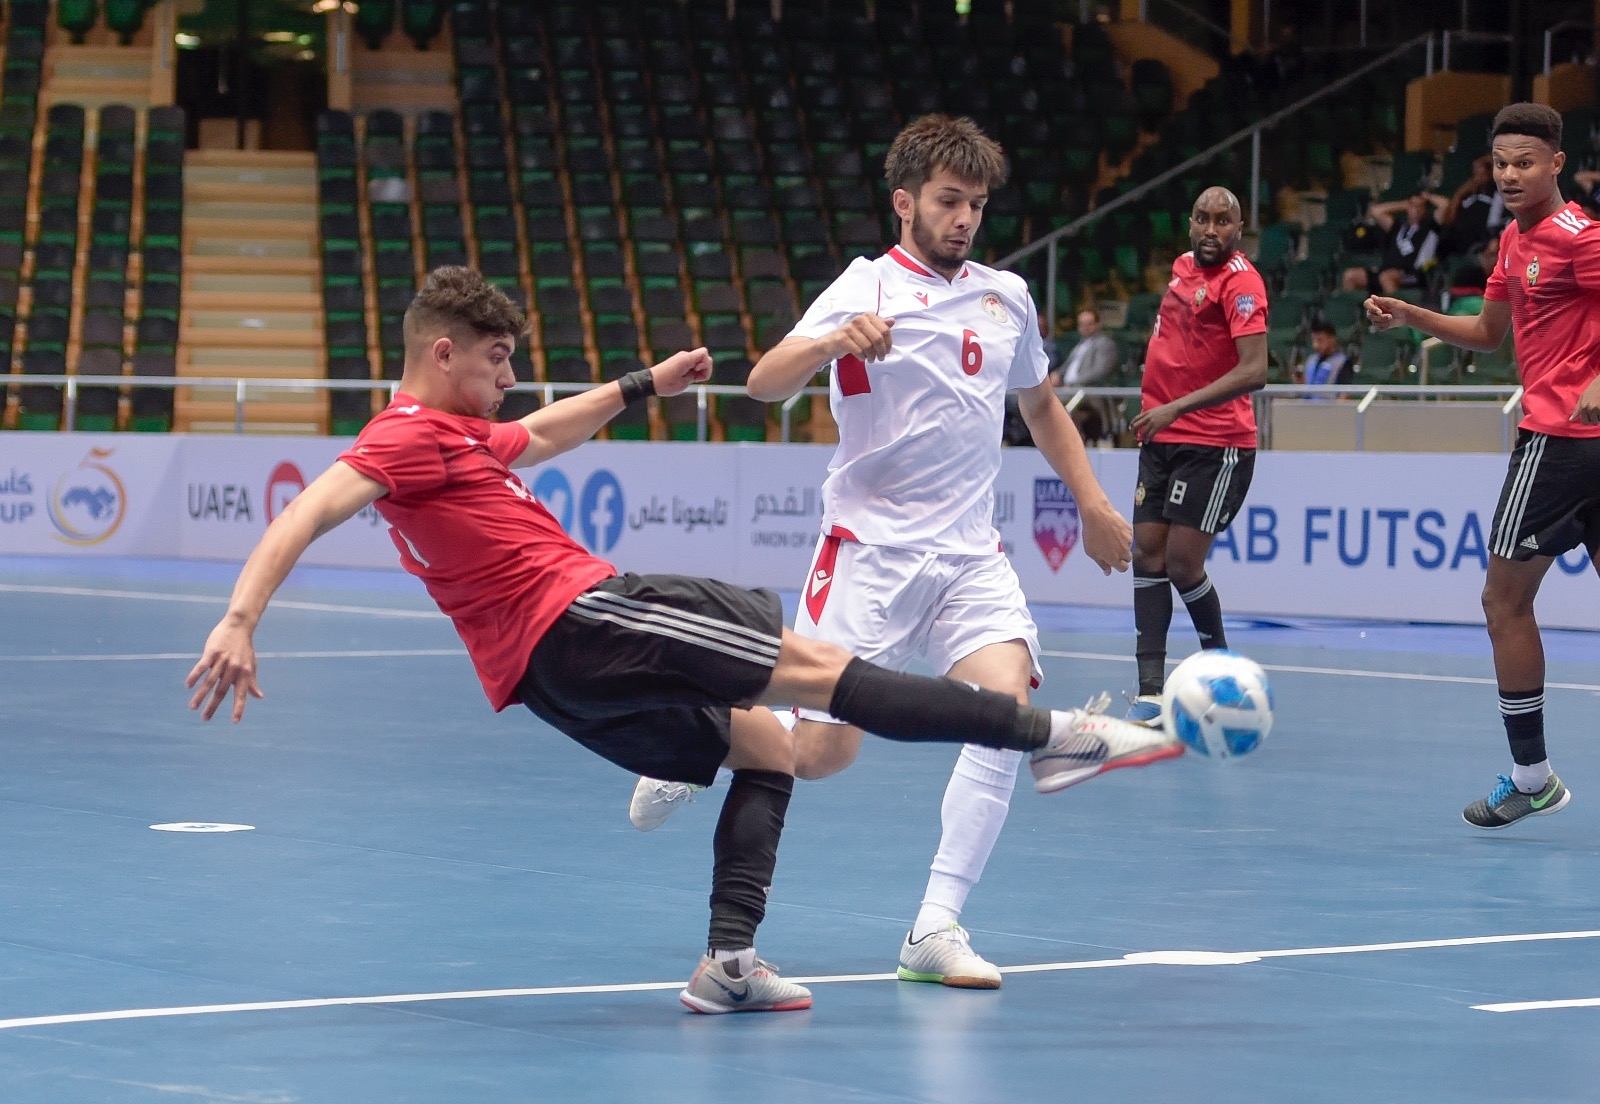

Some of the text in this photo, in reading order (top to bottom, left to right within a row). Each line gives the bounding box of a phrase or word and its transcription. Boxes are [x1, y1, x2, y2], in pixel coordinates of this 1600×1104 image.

[961, 328, 983, 376] 6
[187, 483, 253, 521] UAFA
[1170, 480, 1188, 505] 8
[628, 494, 727, 532] تابعونا على
[1206, 506, 1279, 563] AB
[1304, 507, 1489, 570] FUTSA
